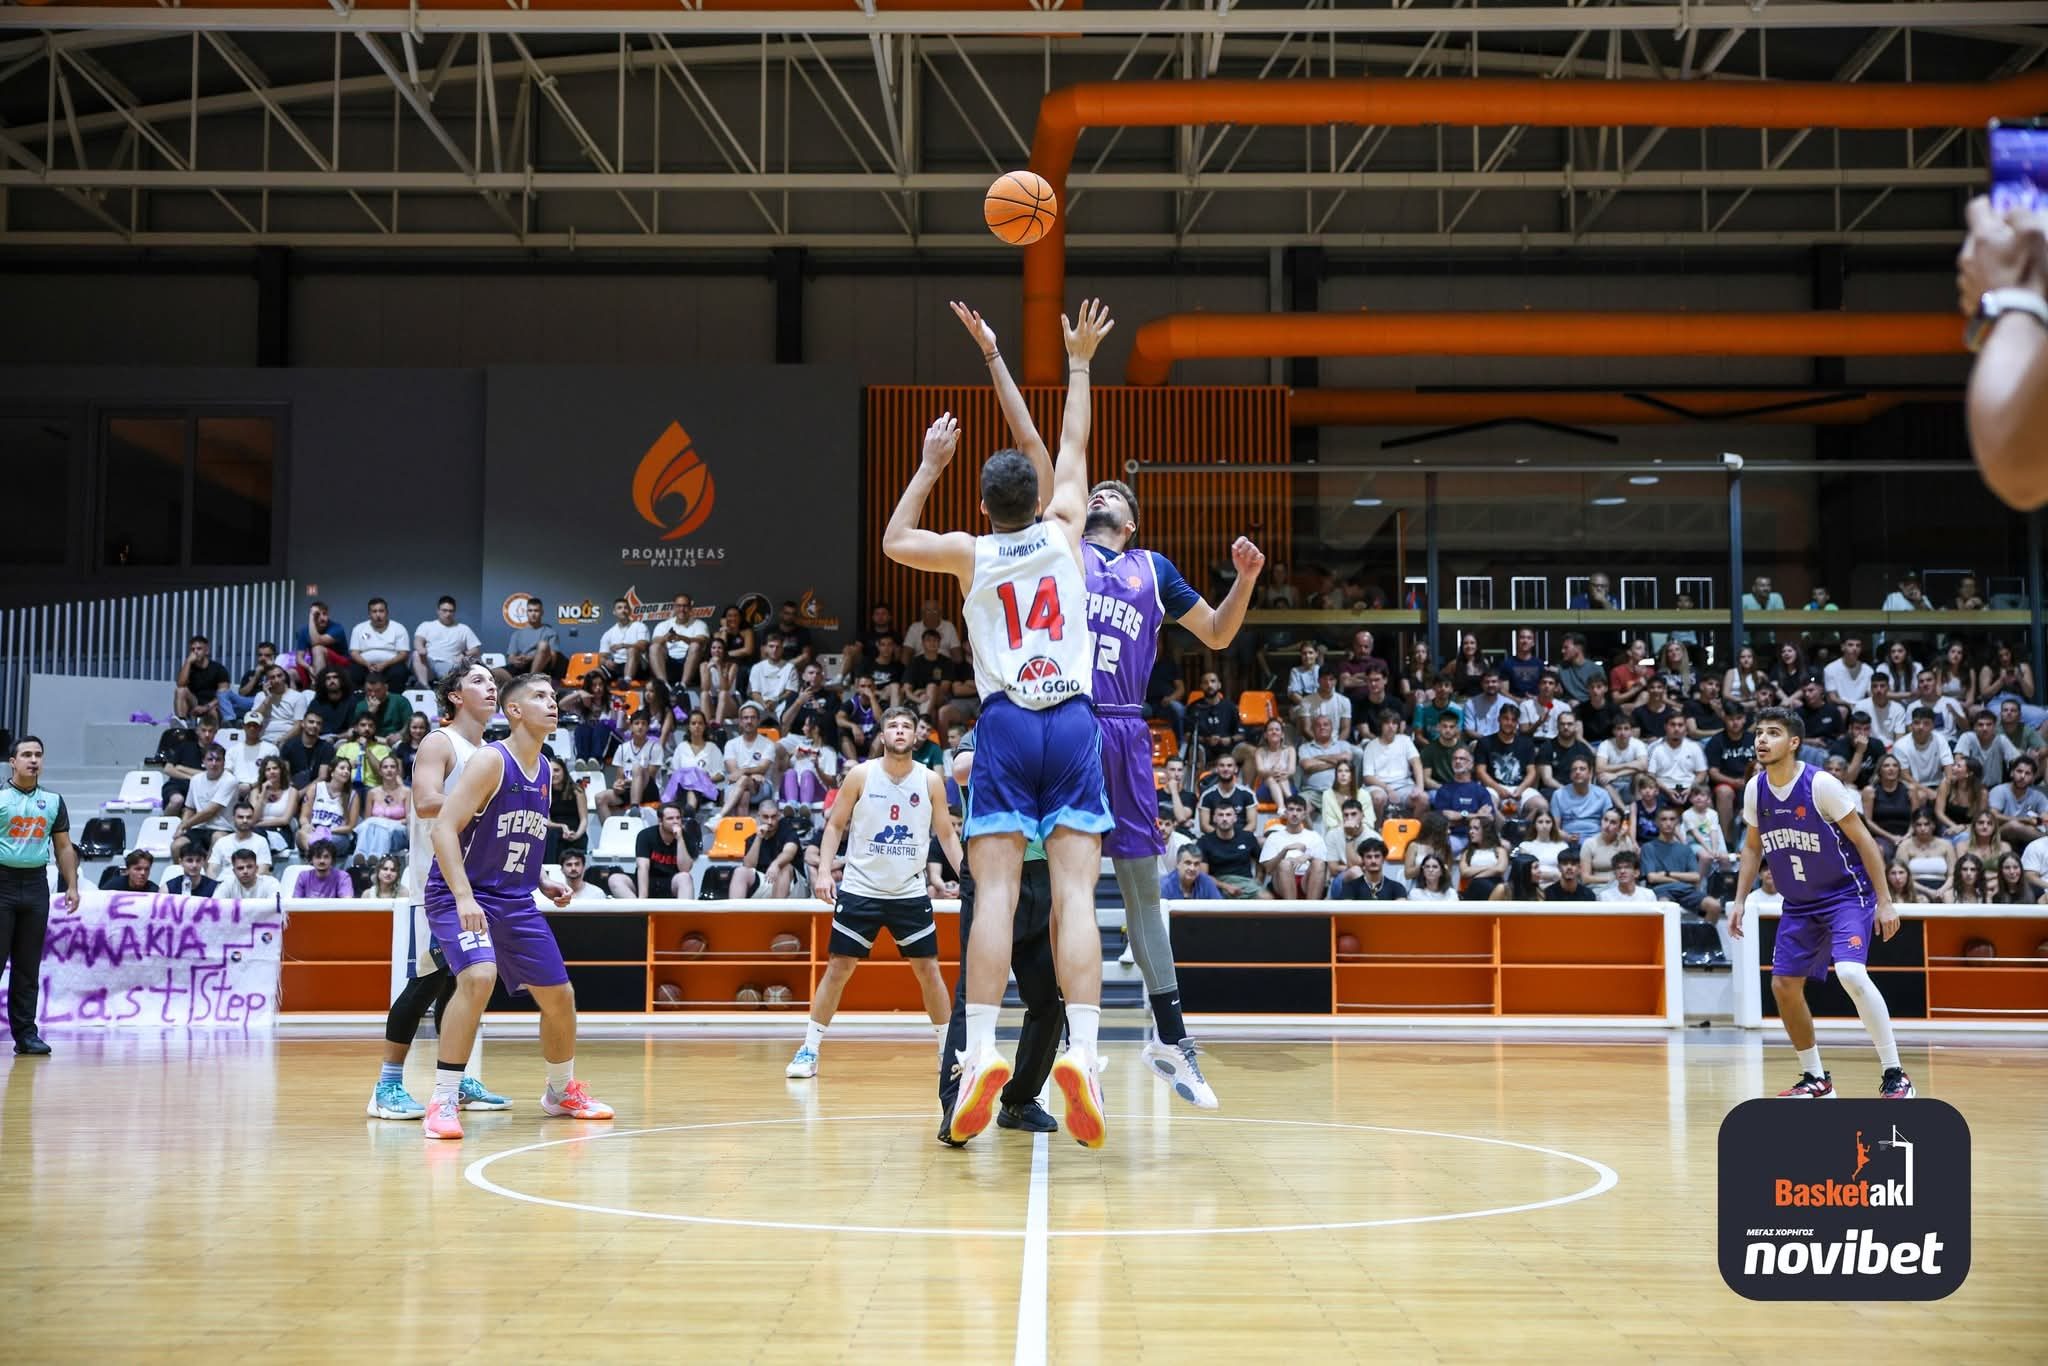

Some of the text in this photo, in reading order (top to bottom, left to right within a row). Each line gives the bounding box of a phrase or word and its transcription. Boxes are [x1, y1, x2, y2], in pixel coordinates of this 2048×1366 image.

[622, 548, 725, 559] PROMITHEAS
[651, 559, 697, 568] PATRAS
[997, 576, 1065, 650] 14
[1086, 591, 1144, 641] PPERS
[890, 804, 900, 820] 8
[869, 843, 916, 857] CINE KASTRO
[1761, 830, 1821, 856] STEPPERS
[1789, 855, 1807, 882] 2
[457, 930, 491, 952] 23
[40, 967, 187, 1023] Last
